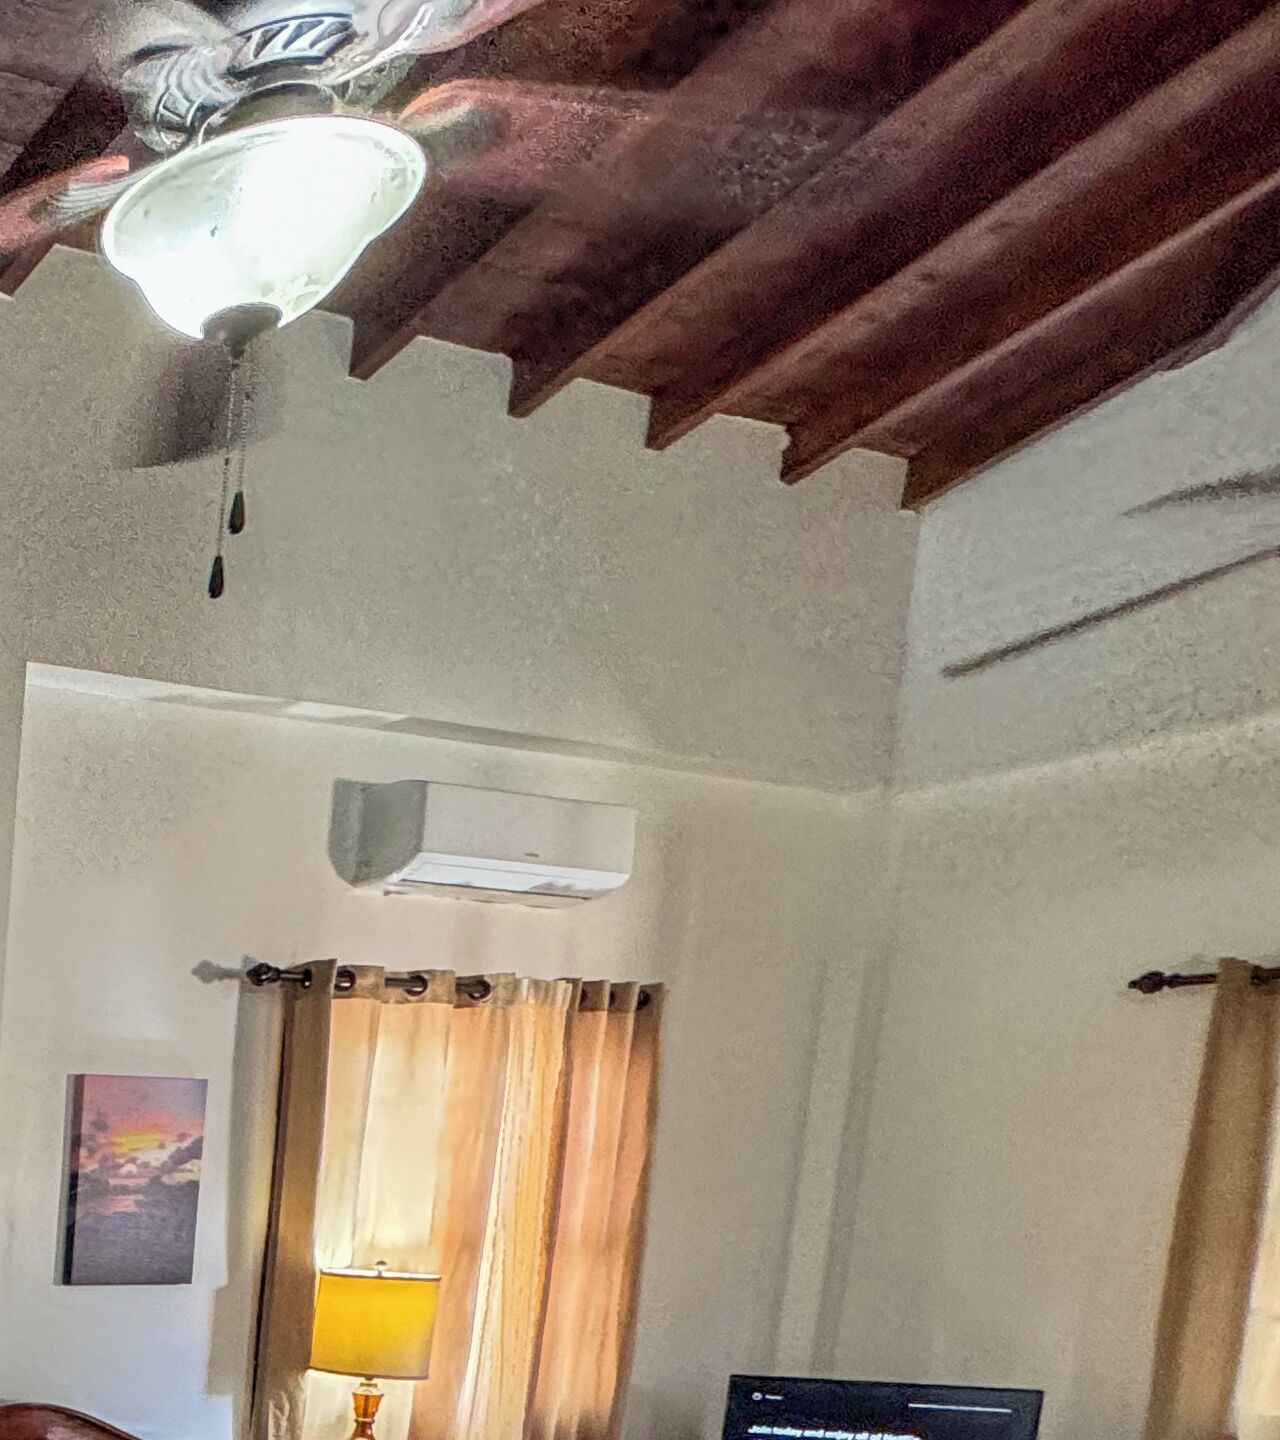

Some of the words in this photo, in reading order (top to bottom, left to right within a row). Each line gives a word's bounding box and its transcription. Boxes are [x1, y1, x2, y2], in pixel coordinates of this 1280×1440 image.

[773, 1427, 803, 1438] today
[804, 1429, 824, 1438] and
[825, 1430, 855, 1440] enjoy
